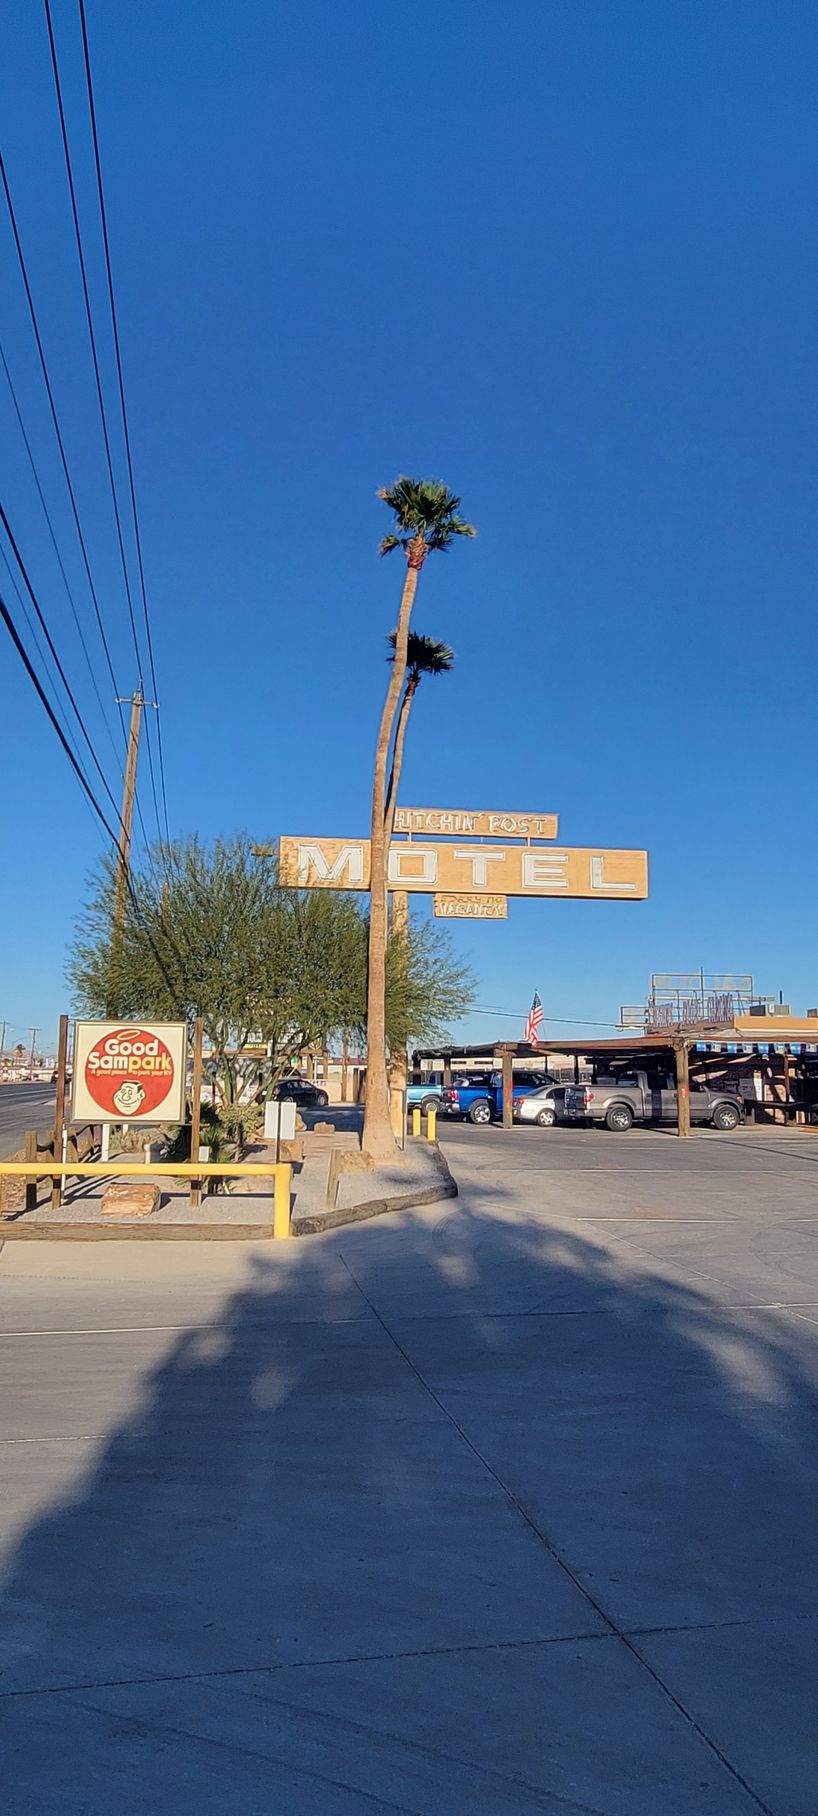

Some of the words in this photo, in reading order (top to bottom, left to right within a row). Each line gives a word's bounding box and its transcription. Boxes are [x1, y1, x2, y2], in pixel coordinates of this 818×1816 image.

[489, 815, 547, 835] POST
[297, 844, 636, 890] MOTEL
[105, 1039, 158, 1055] Good
